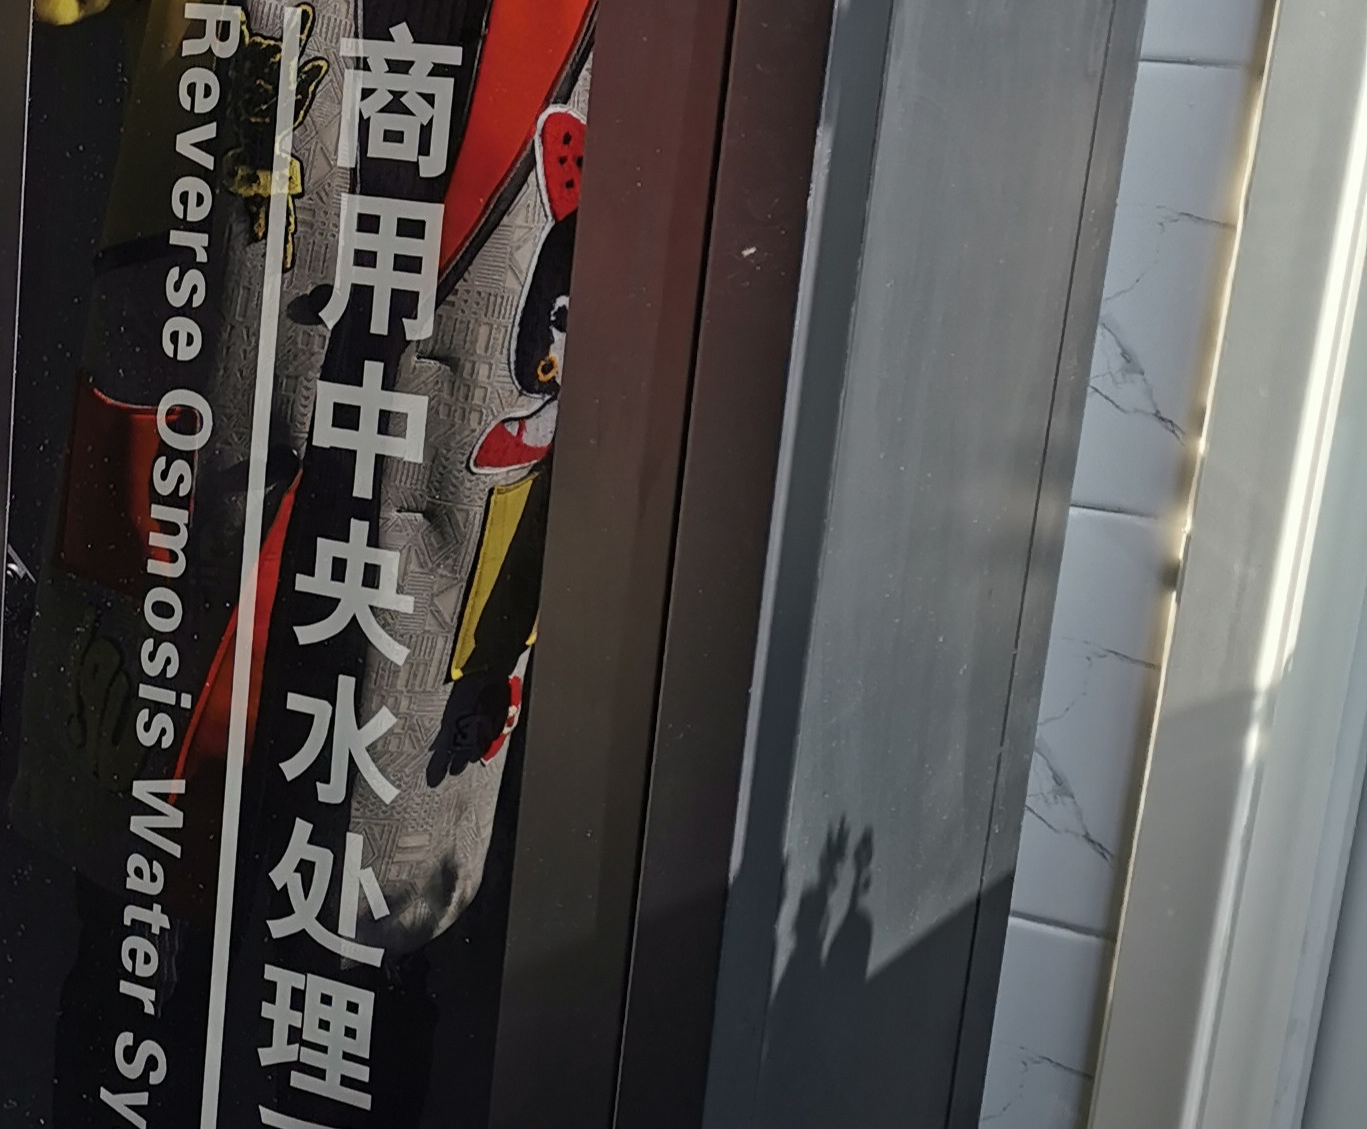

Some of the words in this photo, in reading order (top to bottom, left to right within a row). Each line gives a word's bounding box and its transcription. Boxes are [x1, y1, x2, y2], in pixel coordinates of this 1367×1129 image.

[162, 3, 242, 361] Reverse
[135, 388, 213, 750] Osmosis
[257, 22, 463, 1129] 商用中央水处理
[119, 779, 186, 1016] Water
[100, 1031, 167, 1129] Sy
